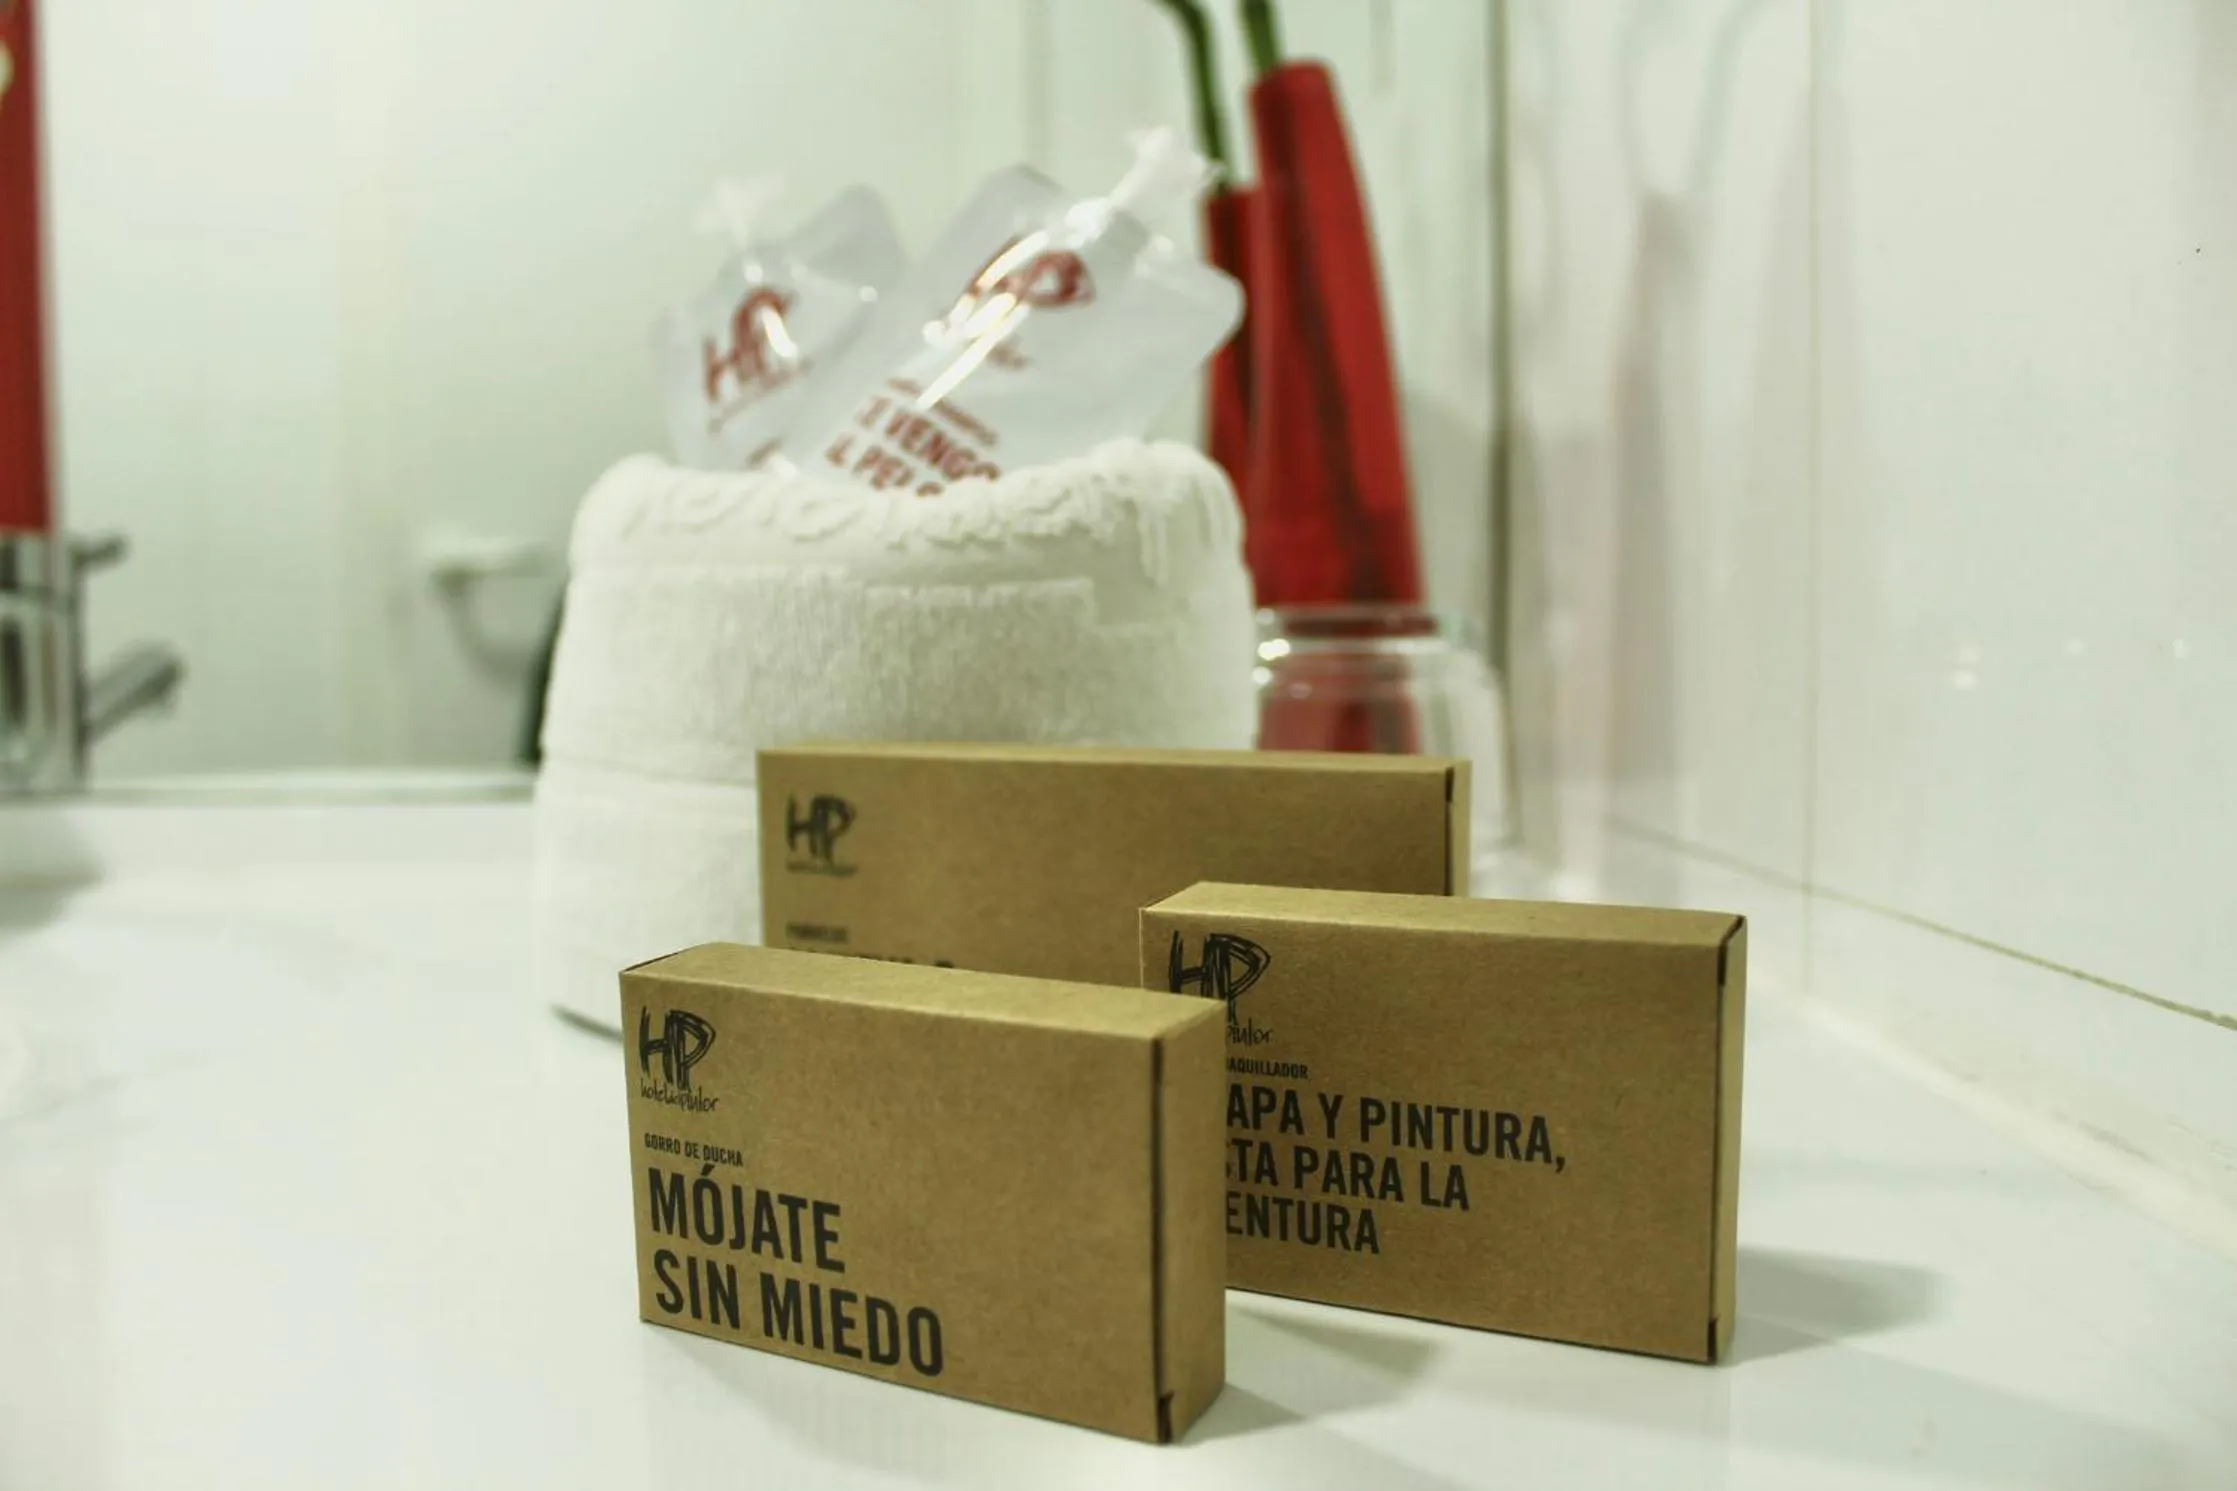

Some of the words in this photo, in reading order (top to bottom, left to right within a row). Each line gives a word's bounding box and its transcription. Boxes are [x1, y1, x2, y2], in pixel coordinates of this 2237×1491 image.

[785, 792, 858, 868] HP
[639, 1004, 717, 1093] HP
[1226, 1055, 1309, 1080] AQUILLADOR
[644, 1131, 682, 1157] GORRO
[684, 1139, 701, 1161] DE
[702, 1143, 745, 1168] DUCHA
[1226, 1082, 1305, 1136] APA
[1316, 1092, 1344, 1140] Y
[1359, 1096, 1566, 1174] PINTURA,
[1226, 1136, 1279, 1188] TA
[1293, 1144, 1405, 1204] PARA
[1419, 1160, 1470, 1212] LA
[647, 1163, 846, 1274] MÓJATE
[1226, 1189, 1380, 1255] ENTURA
[653, 1248, 741, 1330] SIN
[759, 1271, 944, 1377] MIEDO
